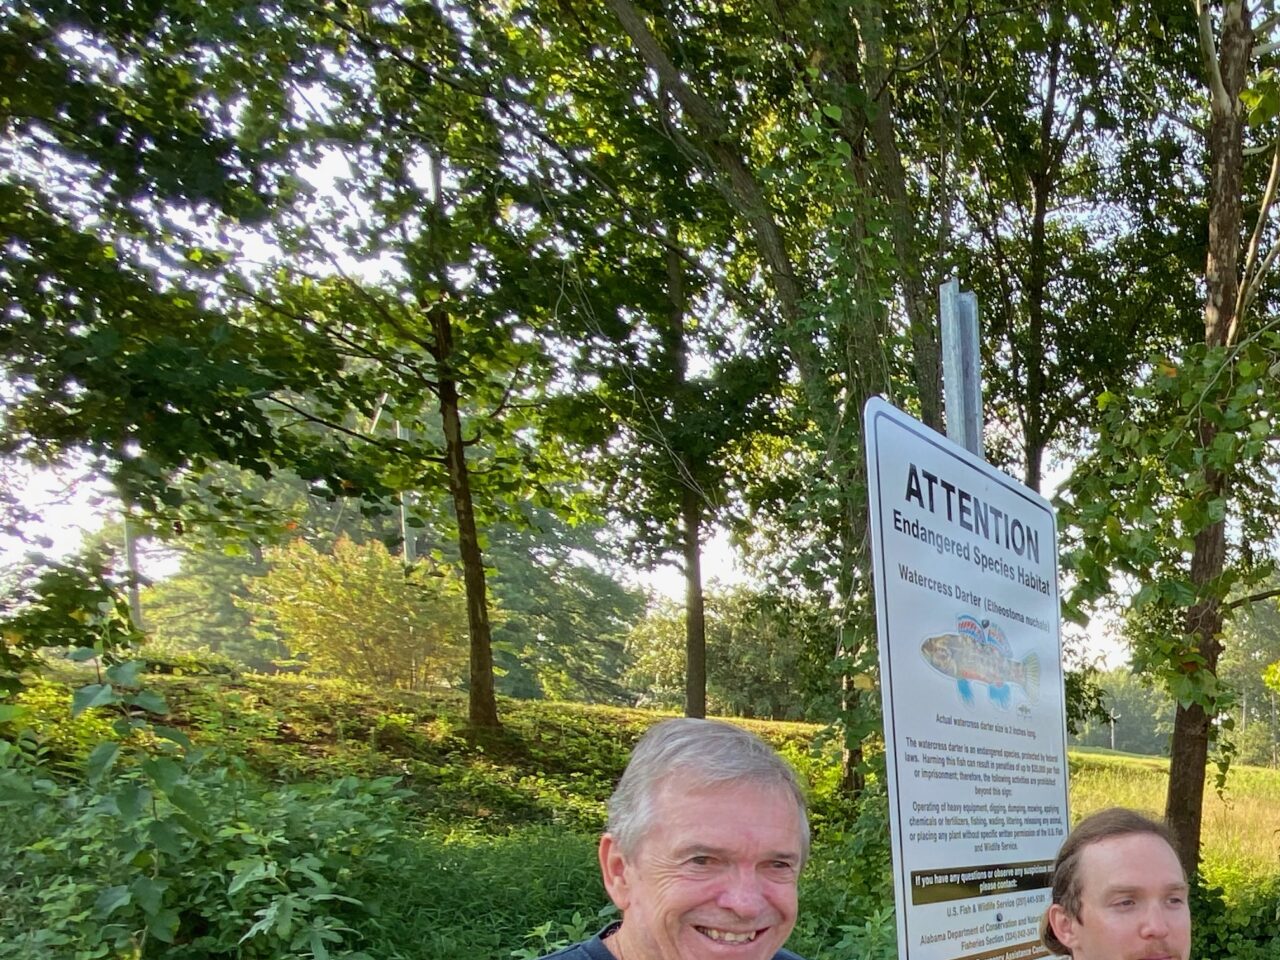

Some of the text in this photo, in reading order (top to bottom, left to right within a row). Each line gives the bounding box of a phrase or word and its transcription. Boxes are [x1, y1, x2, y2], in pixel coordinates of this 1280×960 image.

[905, 462, 1040, 564] ATTENTION
[893, 509, 1050, 596] Endangered Species Habitat
[898, 563, 953, 598] Watercress
[955, 585, 981, 608] Darter
[984, 597, 1024, 623] (Etheostoma
[936, 712, 952, 725] Actual
[953, 717, 979, 730] watercress
[980, 721, 994, 731] darter
[906, 736, 917, 748] The
[918, 739, 947, 751] watercress
[948, 741, 963, 752] darter
[964, 744, 969, 753] is
[970, 746, 976, 754] an
[977, 747, 1003, 758] endangered
[905, 752, 920, 762] laws.
[922, 753, 945, 767] Harming
[946, 756, 955, 766] this
[957, 757, 966, 767] fish
[967, 760, 975, 768] can
[977, 760, 989, 769] result
[996, 762, 1015, 771] penalties
[914, 769, 920, 778] or
[983, 773, 991, 782] the
[992, 773, 1011, 785] following
[1012, 776, 1029, 785] activities
[975, 786, 991, 797] beyond
[993, 787, 1001, 796] this
[913, 801, 939, 814] Operating
[941, 802, 946, 811] of
[947, 802, 961, 814] heavy
[909, 816, 937, 826] chemicals
[938, 818, 944, 826] or
[910, 832, 916, 841] or
[917, 831, 937, 843] placing
[938, 832, 947, 843] any
[949, 830, 961, 842] plant
[962, 830, 979, 839] without
[980, 830, 998, 841] specific
[999, 830, 1013, 838] written
[1014, 830, 1036, 839] permission
[974, 843, 983, 852] and
[984, 842, 1000, 851] Wildlife
[915, 874, 921, 886] If
[921, 876, 933, 888] you
[934, 873, 949, 884] have
[949, 874, 960, 885] any
[961, 870, 987, 884] questions
[987, 870, 993, 879] or
[994, 868, 1014, 878] observe
[1014, 868, 1023, 877] any
[1024, 864, 1047, 876] suspicious
[980, 879, 1018, 894] please contact:
[947, 906, 959, 917] U.S.
[960, 903, 971, 915] Fish
[972, 904, 977, 913] &
[977, 901, 995, 912] Wildlife
[996, 899, 1015, 909] Service
[920, 933, 946, 946] Alabama
[947, 925, 978, 940] Department
[980, 924, 985, 934] of
[986, 919, 1017, 932] Conservation
[1018, 918, 1026, 927] and
[961, 938, 985, 951] Fisheries
[986, 935, 1004, 946] Section
